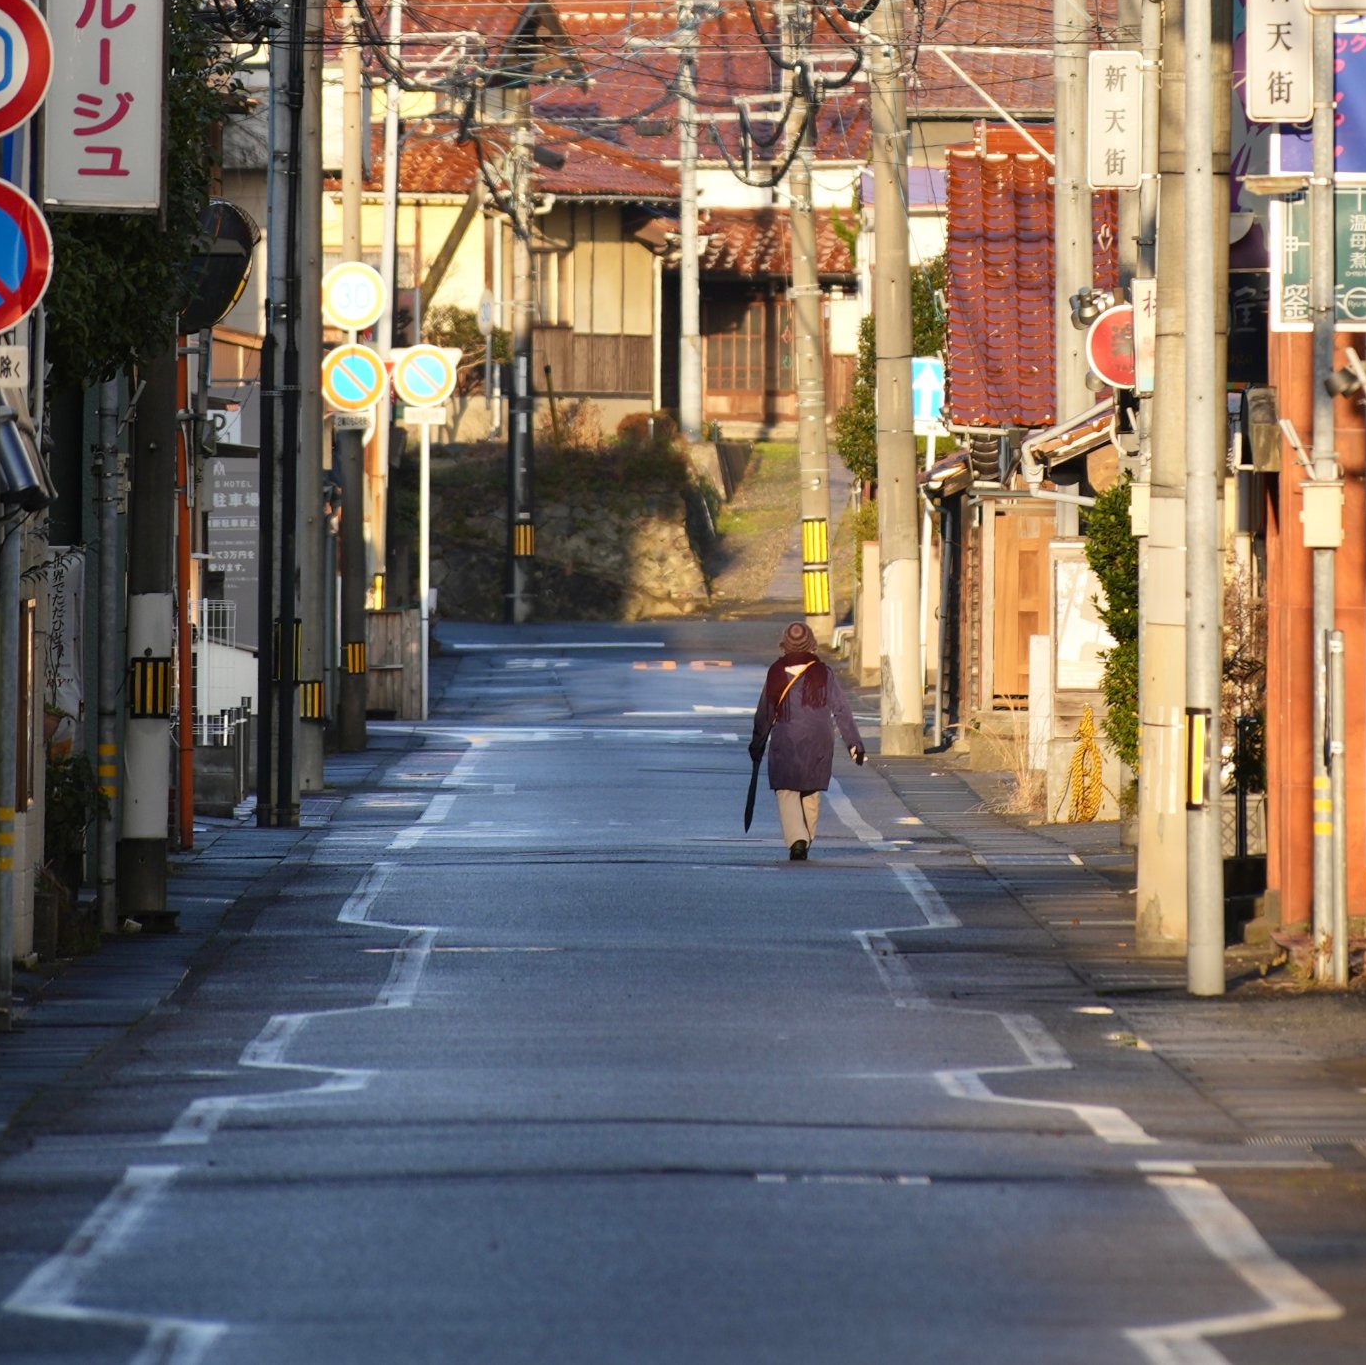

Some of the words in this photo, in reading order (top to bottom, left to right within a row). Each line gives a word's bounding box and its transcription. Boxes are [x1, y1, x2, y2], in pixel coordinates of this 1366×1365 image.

[1104, 65, 1127, 176] 新天街
[339, 283, 370, 309] 30
[213, 492, 259, 508] 駐車場
